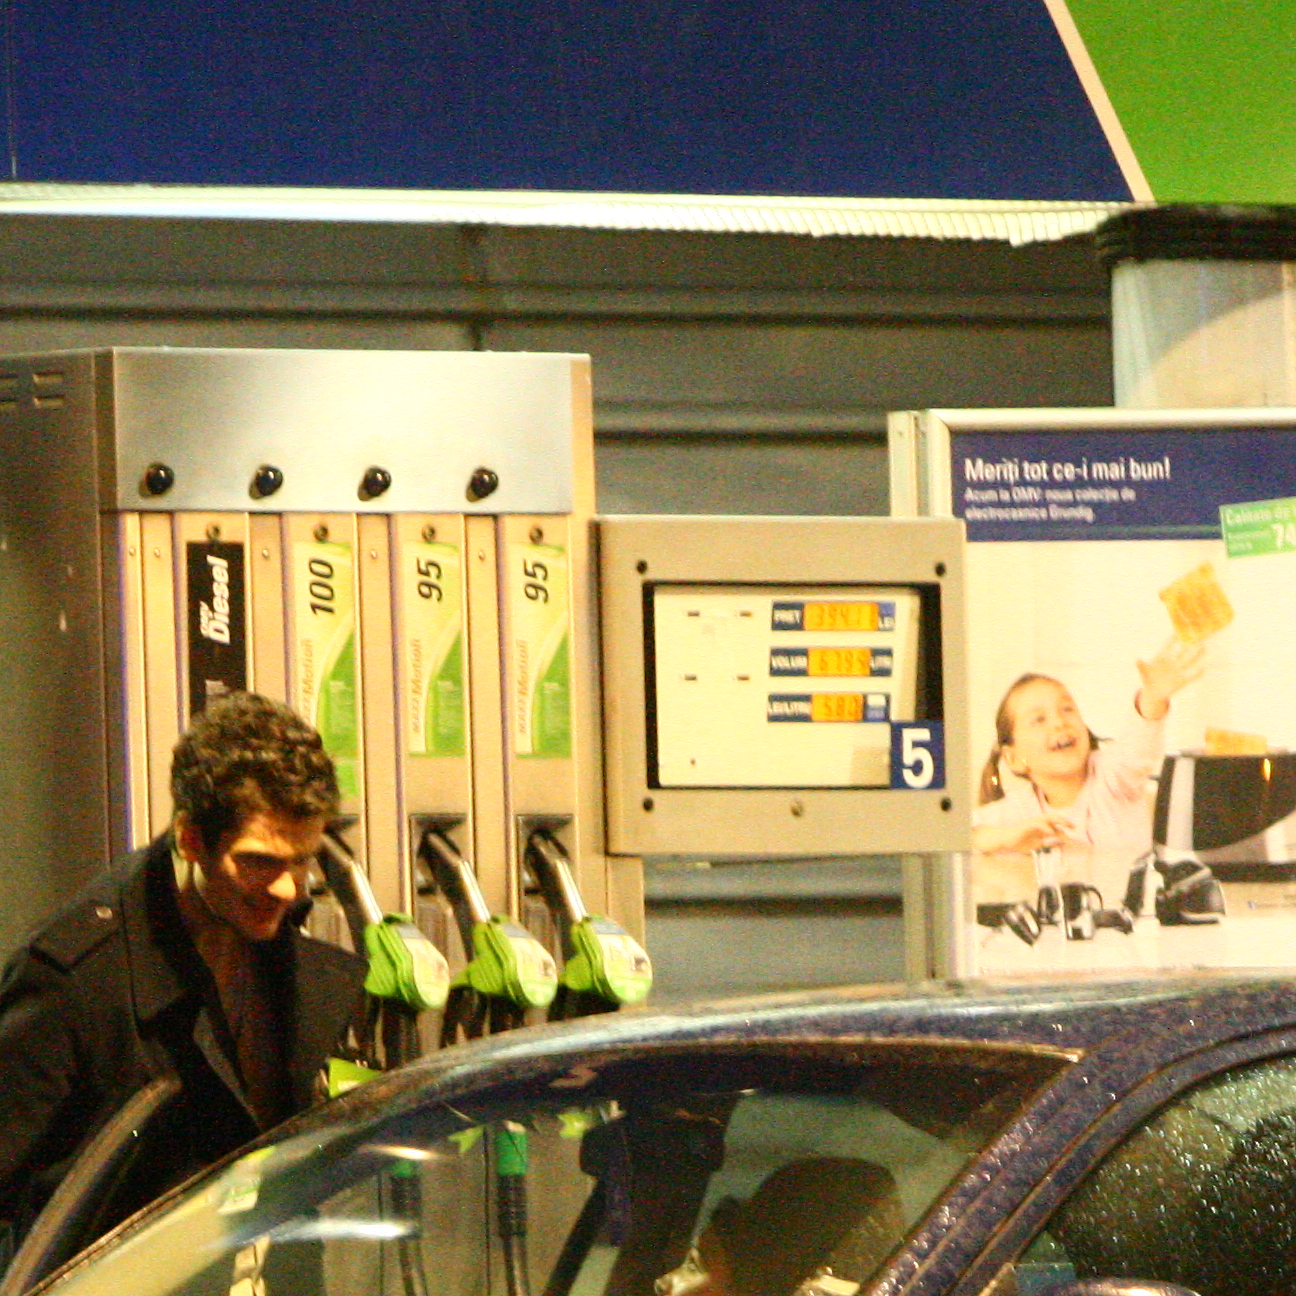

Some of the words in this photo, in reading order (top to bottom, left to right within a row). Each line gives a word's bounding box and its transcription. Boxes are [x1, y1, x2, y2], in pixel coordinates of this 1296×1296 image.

[1022, 460, 1049, 481] tot
[1052, 458, 1088, 481] ce-i
[1092, 457, 1125, 480] mai
[1129, 456, 1172, 481] bun!
[205, 554, 232, 645] Diesel
[308, 558, 336, 618] 100
[417, 557, 443, 603] 95
[524, 558, 550, 605] 95
[902, 727, 935, 790] 5
